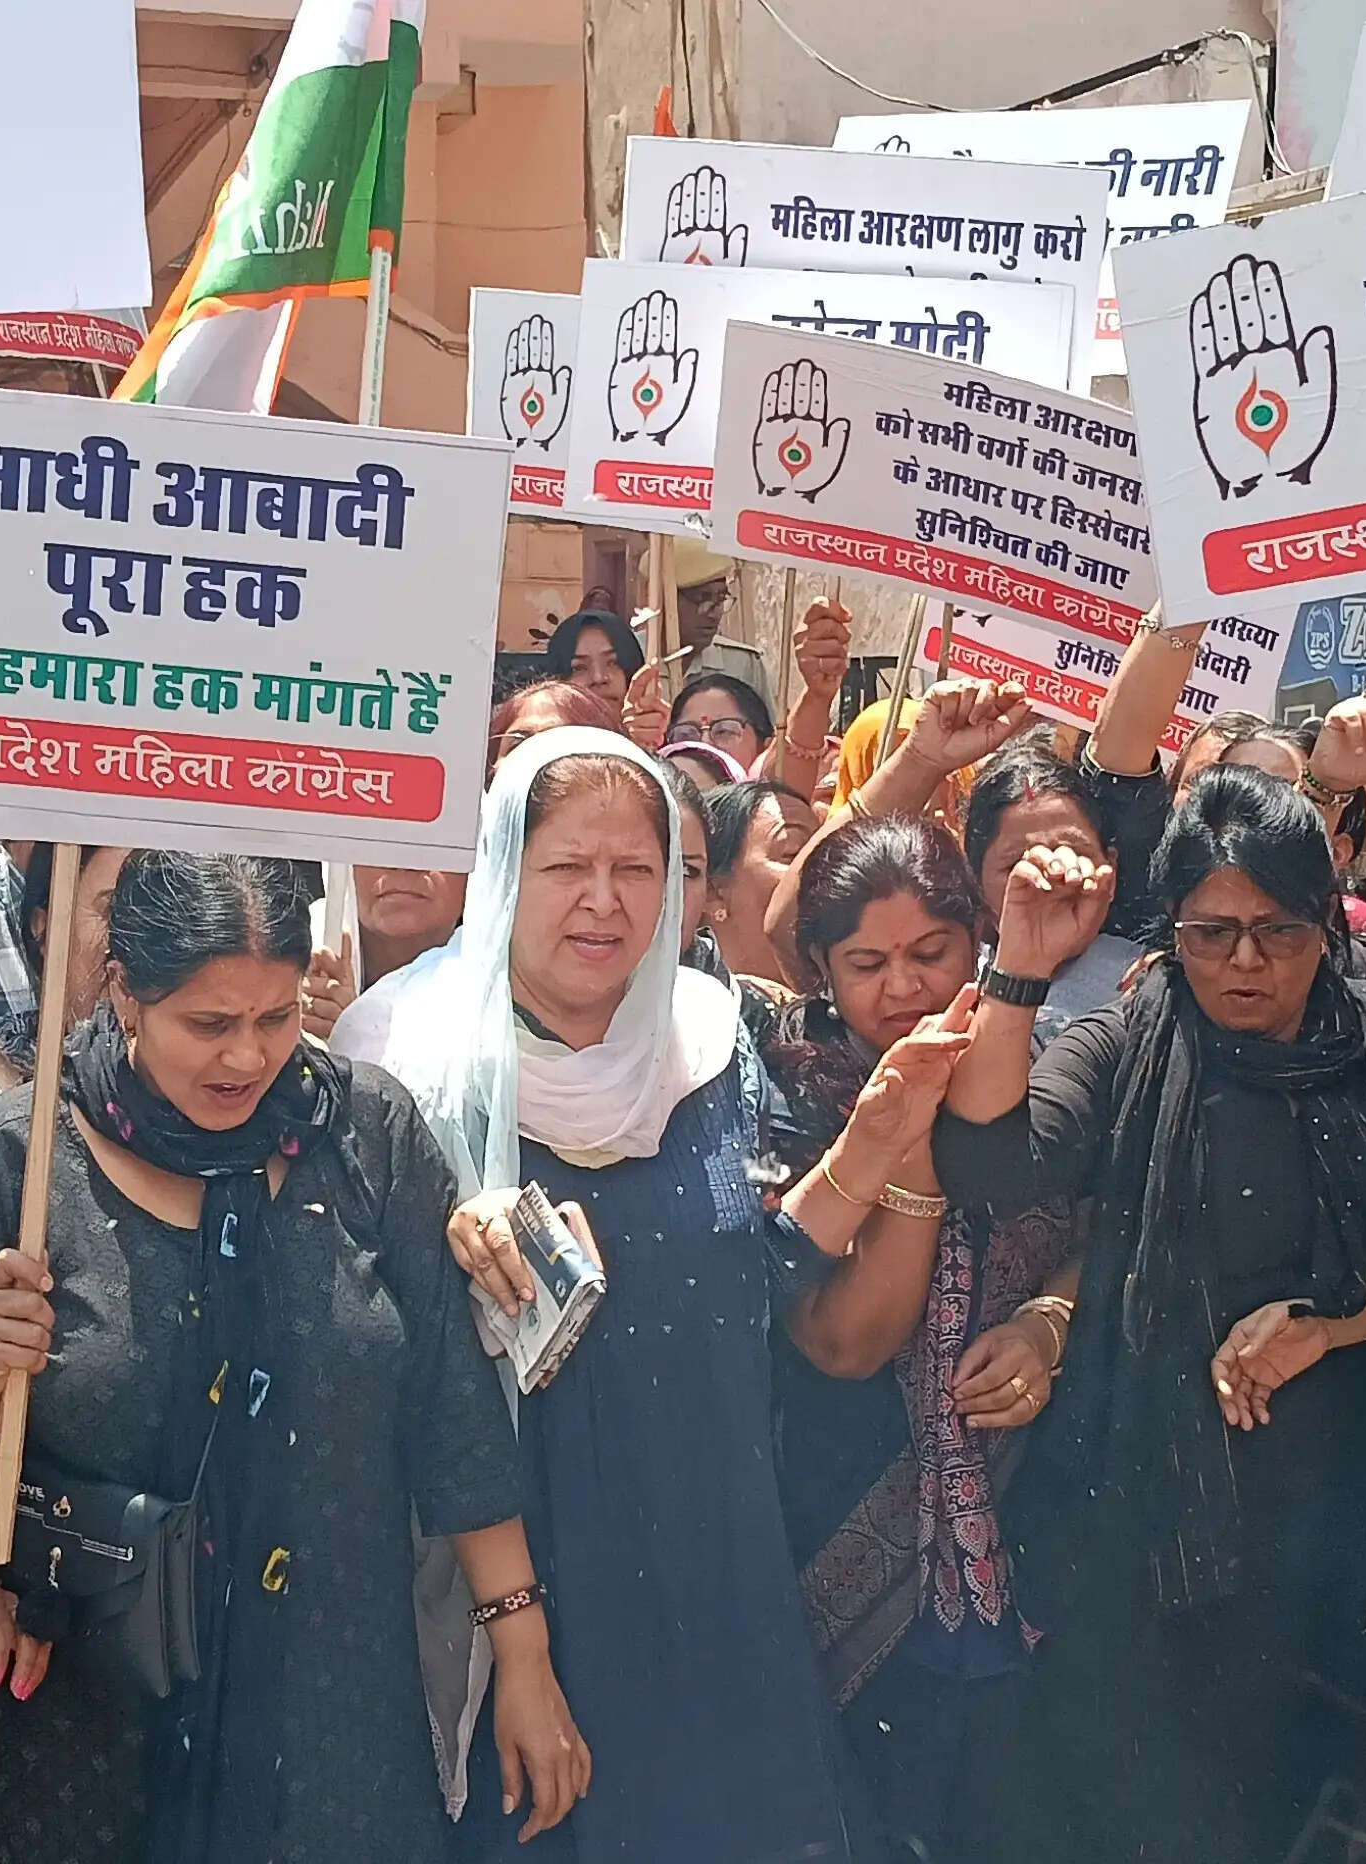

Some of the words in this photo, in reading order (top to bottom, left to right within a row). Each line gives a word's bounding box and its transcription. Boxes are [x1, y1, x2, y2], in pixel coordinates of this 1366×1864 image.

[1141, 145, 1225, 196] नारी
[771, 196, 855, 242] महिला
[859, 209, 964, 253] आरक्षण
[968, 221, 1024, 269] लागु
[1033, 215, 1087, 262] करो
[53, 316, 84, 352] प्रदेश
[82, 319, 118, 355] महिला
[944, 381, 1031, 424] महिला
[1035, 404, 1138, 457] आरक्षण
[875, 408, 914, 437] को
[918, 418, 974, 455] सभी
[1034, 448, 1070, 481] की
[1073, 461, 1144, 505] जनस
[893, 456, 921, 484] के
[926, 467, 1007, 508] आधार
[1012, 489, 1047, 521] पर
[154, 463, 415, 550] आबादी
[763, 522, 887, 567] राजस्थान
[894, 543, 957, 586] प्रदेश
[963, 565, 1045, 610] महिला
[1052, 592, 1148, 638] कांग्रेस
[915, 508, 1032, 560] सुनिश्चित
[1036, 539, 1072, 573] की
[1075, 554, 1131, 591] जाए
[45, 543, 170, 637] पूरा
[183, 557, 307, 628] हक
[1311, 631, 1330, 649] ZPS
[153, 659, 239, 715] हक
[253, 661, 399, 731] मांगते
[409, 671, 452, 734] हैं
[1035, 672, 1084, 706] प्रदेश
[95, 735, 235, 792] महिला
[248, 747, 395, 805] कांग्रेस
[17, 1482, 45, 1498] OVE
